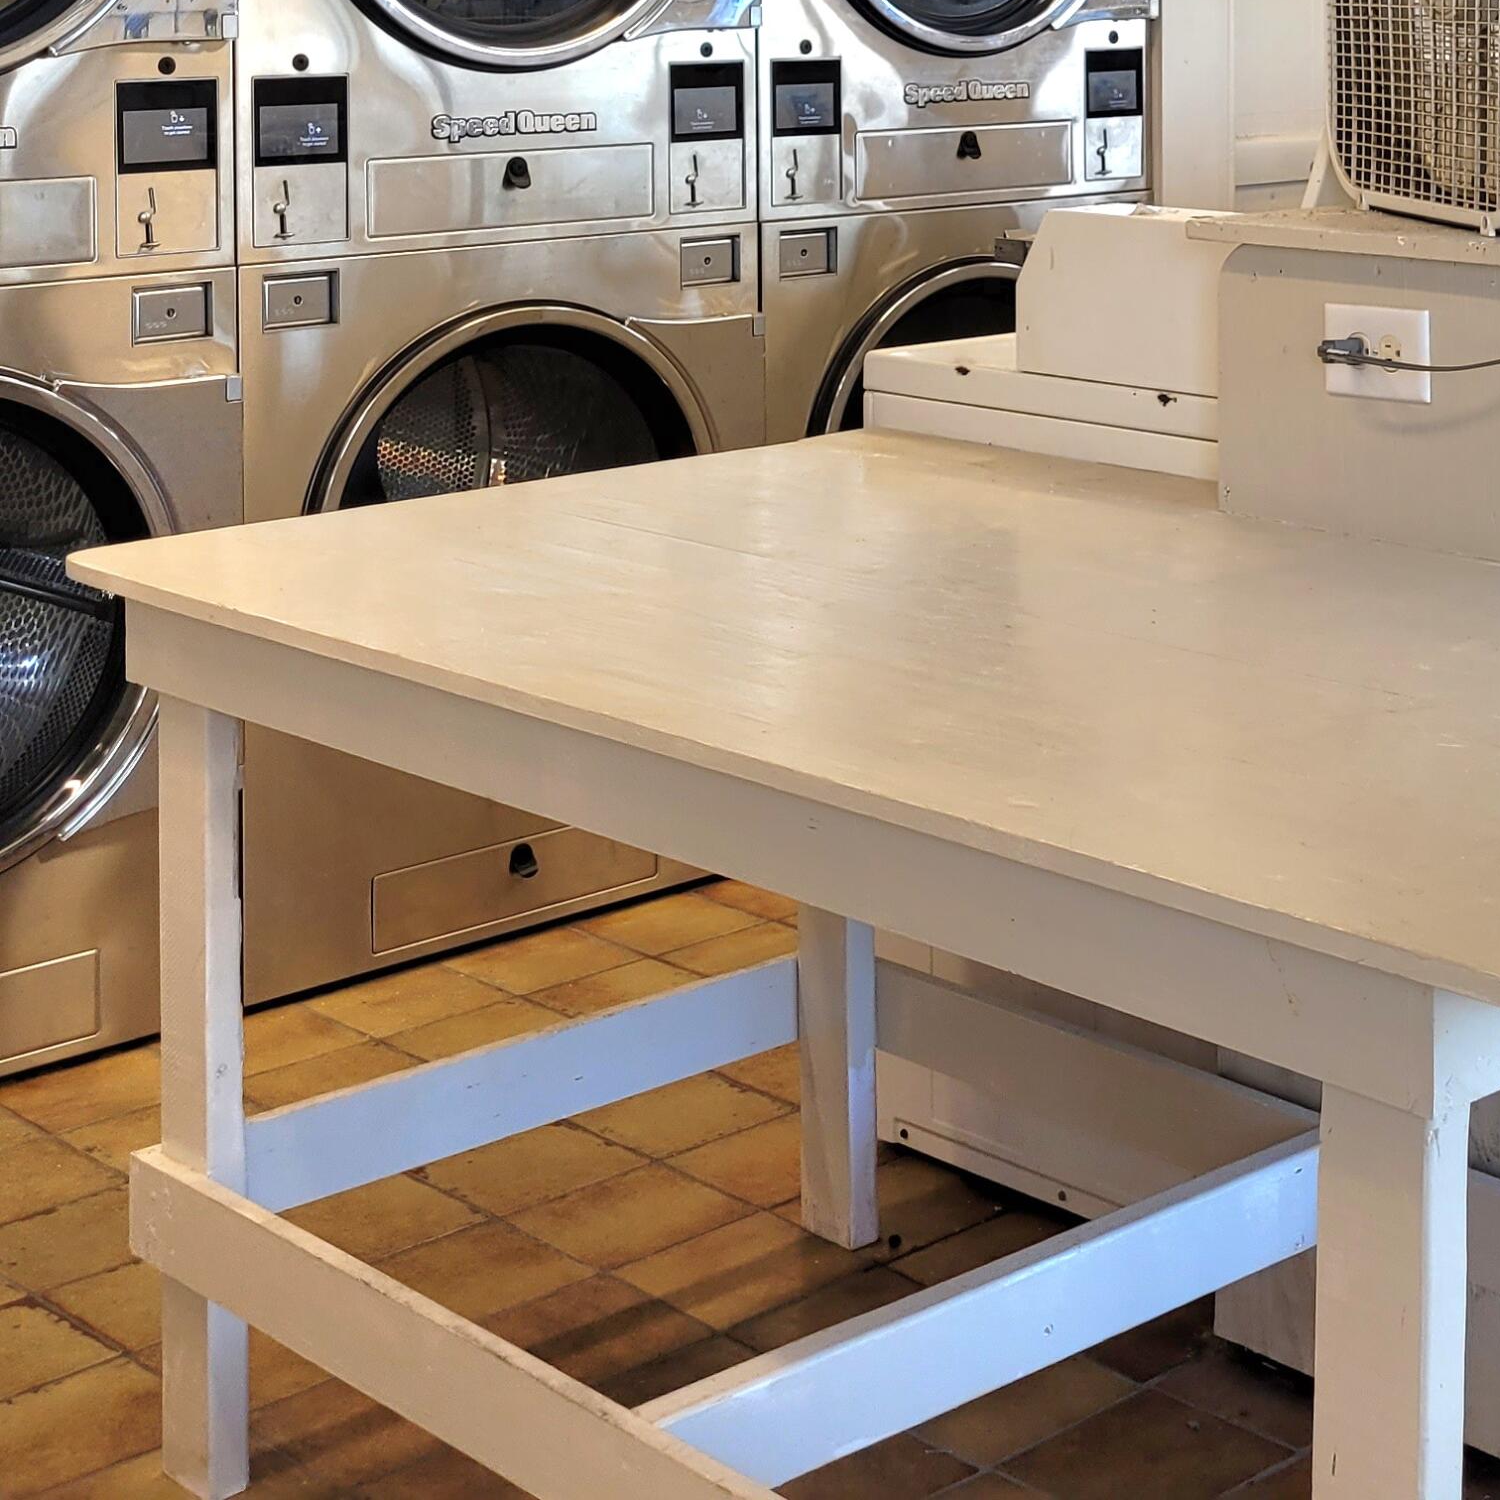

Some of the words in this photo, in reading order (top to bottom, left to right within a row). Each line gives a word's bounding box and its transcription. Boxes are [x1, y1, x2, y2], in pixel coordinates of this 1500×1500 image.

[903, 80, 968, 108] Speed
[968, 79, 1030, 101] Queen
[431, 111, 517, 143] Speed
[516, 110, 598, 134] Queen
